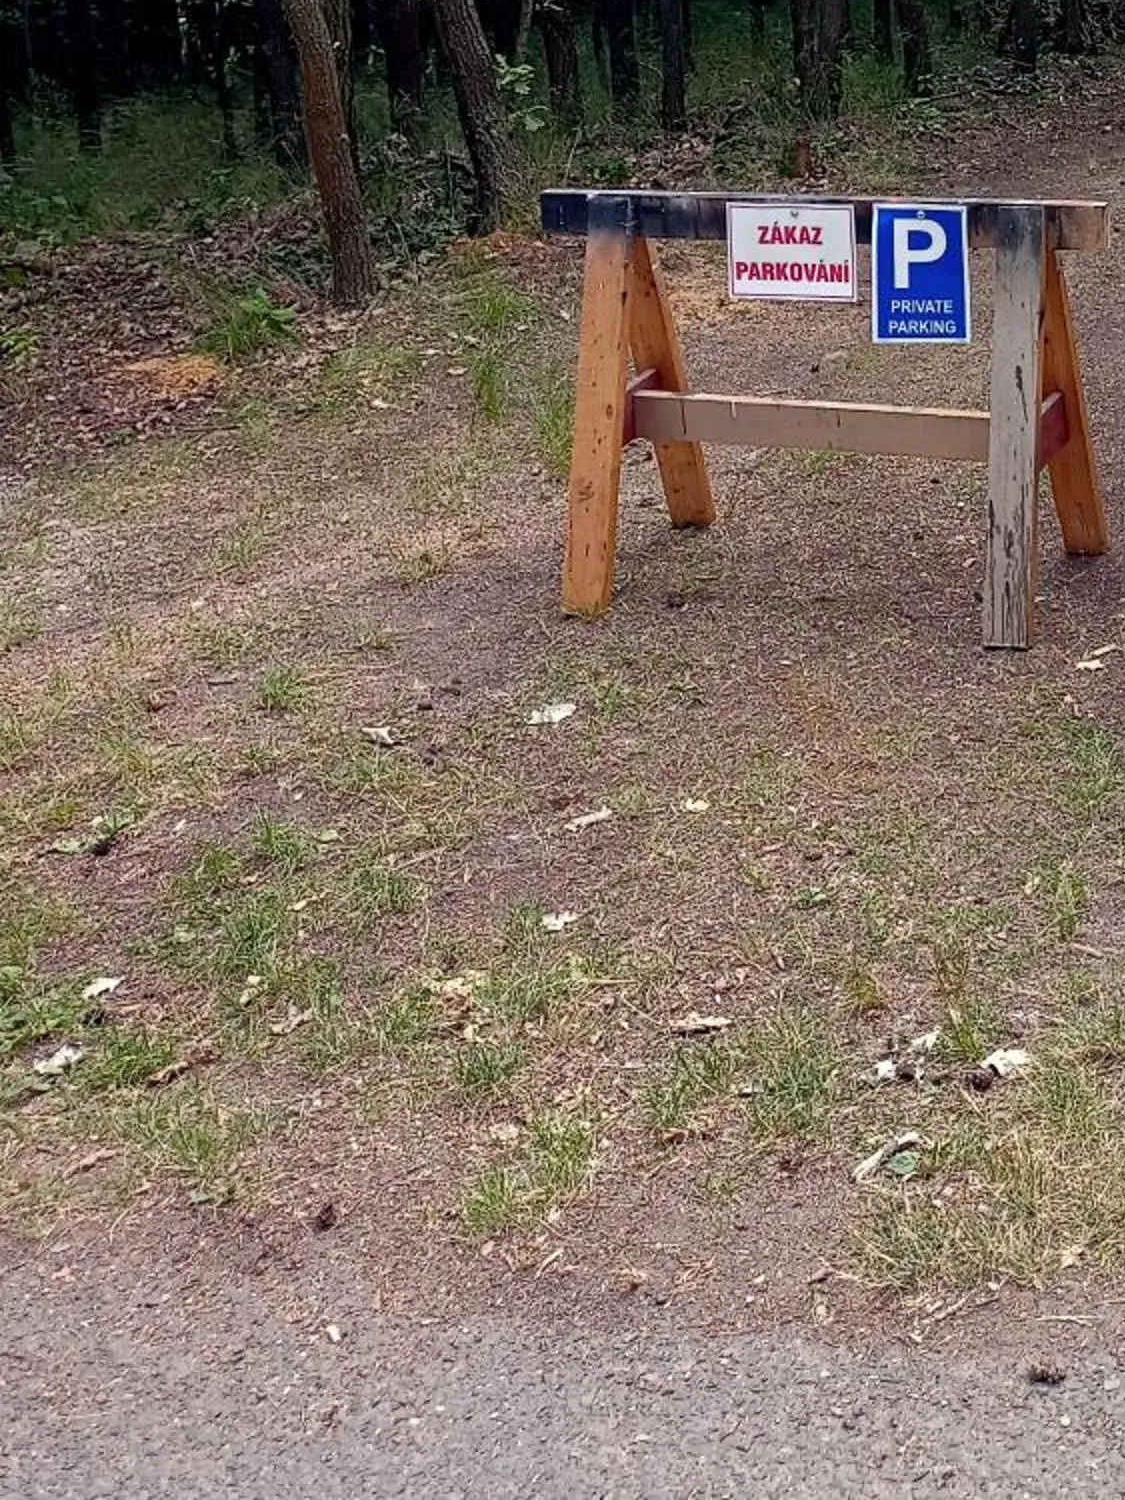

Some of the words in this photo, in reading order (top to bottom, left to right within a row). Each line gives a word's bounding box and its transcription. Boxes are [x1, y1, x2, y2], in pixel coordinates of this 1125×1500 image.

[757, 221, 824, 246] ZÁKAZ
[893, 217, 948, 289] P
[734, 258, 850, 284] PARKOVÁNÍ
[890, 299, 953, 315] PRIVATE
[888, 318, 957, 336] PARKING
